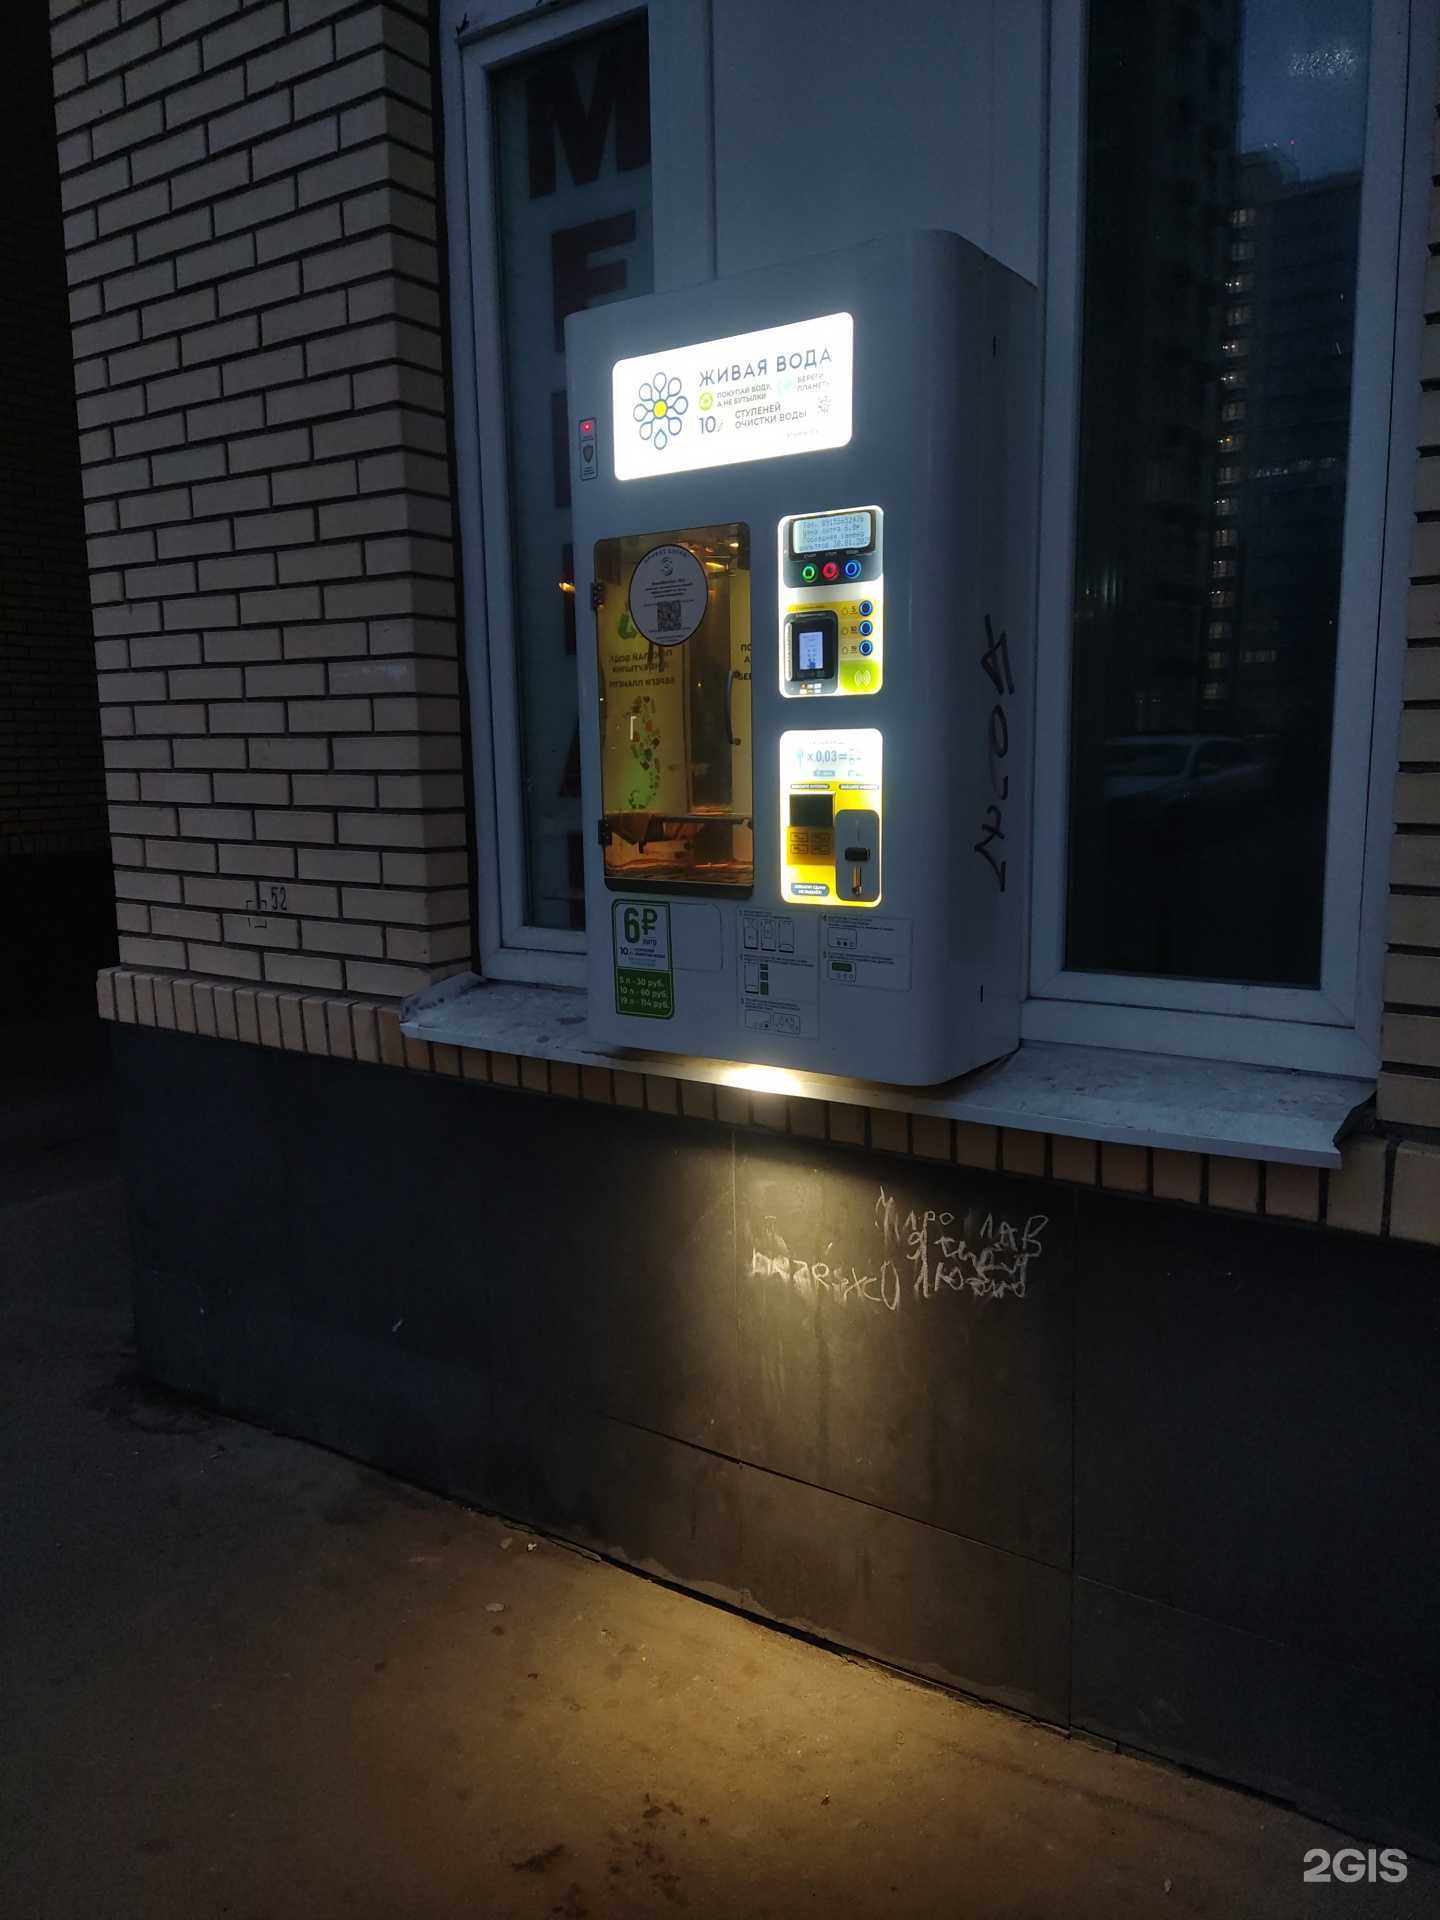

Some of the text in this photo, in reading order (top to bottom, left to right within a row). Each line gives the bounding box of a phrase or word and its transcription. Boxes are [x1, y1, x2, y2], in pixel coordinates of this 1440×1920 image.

[699, 348, 832, 387] ЖИВАЯ ВОДА
[717, 385, 750, 398] ПОКУПАЙ
[733, 393, 767, 405] БУТЫЛКИ
[735, 401, 781, 419] СТУПЕНЕЙ
[735, 409, 807, 429] ОЧИСТКИ ВОДЫ
[698, 415, 717, 434] 10
